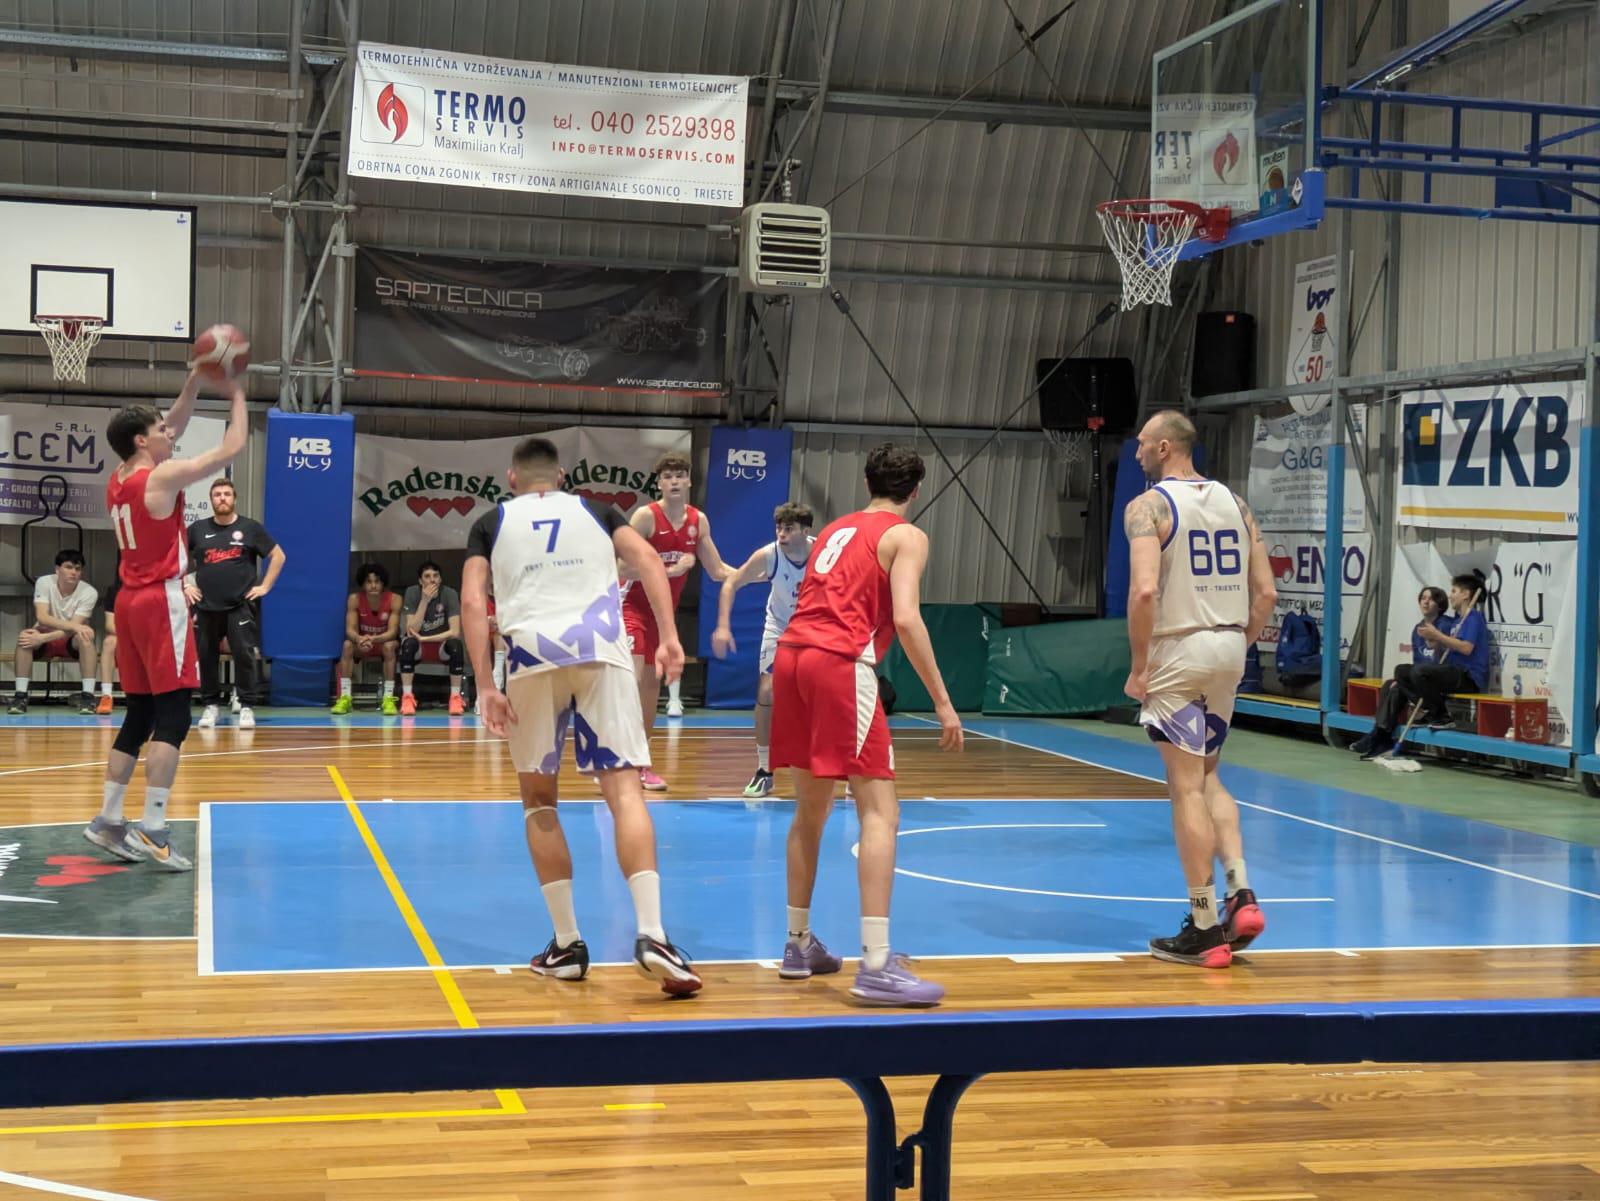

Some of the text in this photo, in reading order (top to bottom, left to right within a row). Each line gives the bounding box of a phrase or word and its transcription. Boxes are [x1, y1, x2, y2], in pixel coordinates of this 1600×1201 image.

[362, 50, 458, 71] TERMOTEHNIČNA
[464, 62, 542, 80] VZDRŽEVANJA
[559, 72, 643, 88] MANUTENZIONI
[650, 80, 738, 94] TERMOTECNICHE
[434, 89, 526, 125] TERMO
[436, 117, 524, 140] SERVIS
[553, 110, 736, 141] tel. 040 2529398
[434, 136, 524, 159] Maximilian Kralj
[552, 141, 735, 165] INFO@TERMOSERVIS.COM
[357, 160, 401, 174] OBRTNA
[405, 164, 435, 177] CONA
[440, 167, 481, 181] ZGONIK
[492, 172, 516, 184] TRST
[527, 175, 556, 187] ZONA
[559, 178, 628, 193] ARTIGIANALE
[633, 184, 680, 197] SGONICO
[694, 187, 734, 201] TRIESTE
[376, 277, 543, 309] SAPTECNICA
[1306, 285, 1335, 312] bor
[616, 377, 722, 389] www.saptecnica.com
[1306, 355, 1323, 382] 50
[55, 422, 96, 433] S.R.L.
[1447, 396, 1571, 488] ZKB
[0, 431, 95, 464] CEM
[289, 437, 332, 456] KB
[727, 449, 766, 467] KB
[1282, 446, 1323, 470] G&G
[561, 458, 664, 500] adensk
[111, 503, 137, 550] 11
[531, 518, 561, 553] 7
[814, 527, 857, 574] 8
[1188, 529, 1241, 576] 66
[1296, 546, 1366, 586] ENO
[1514, 562, 1551, 624] "G"
[1538, 632, 1544, 643] 4
